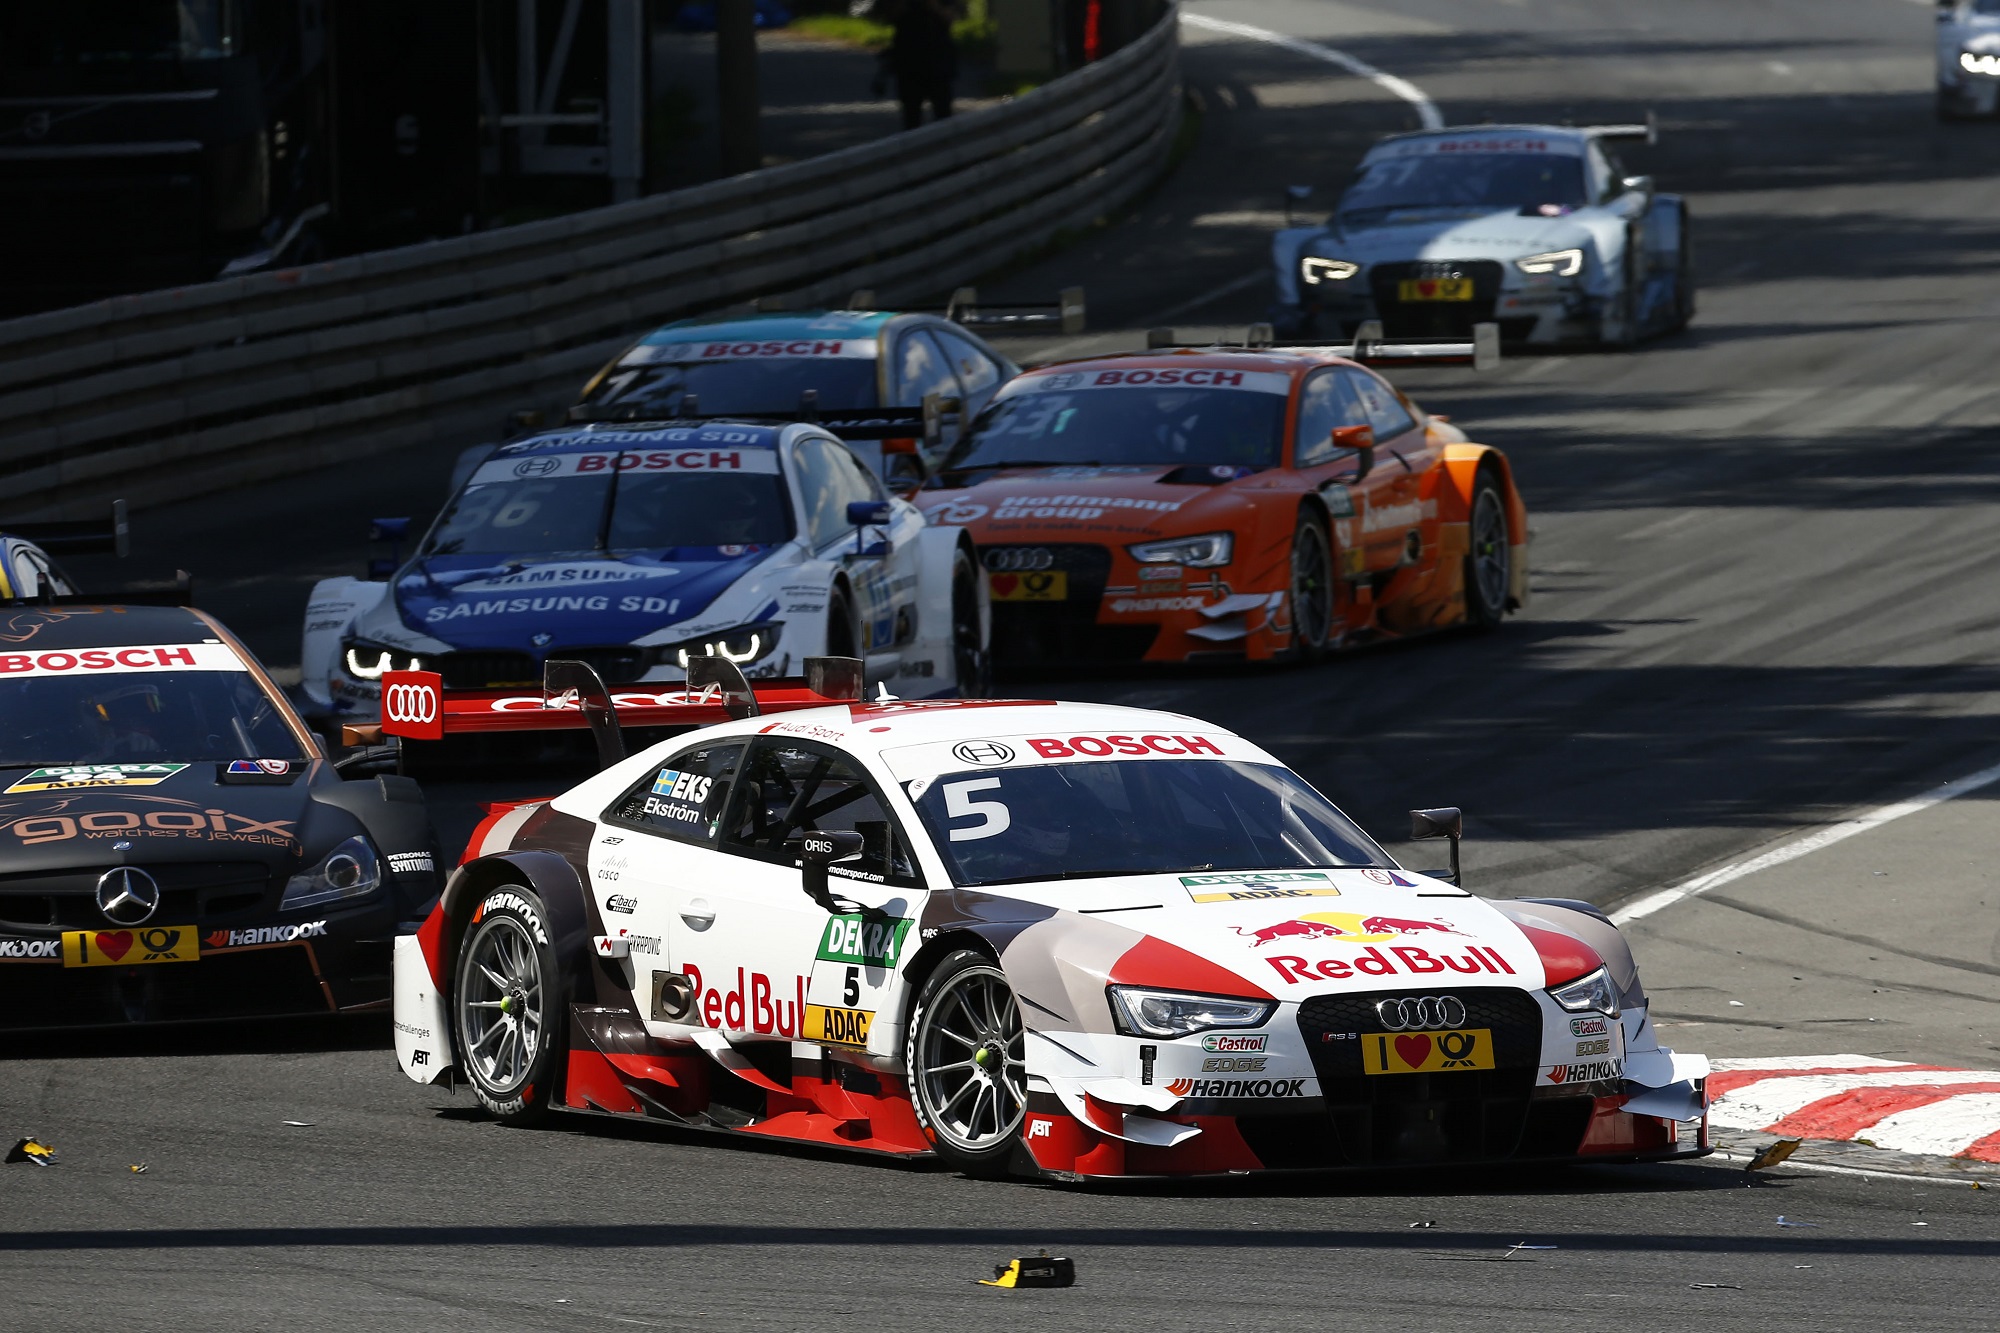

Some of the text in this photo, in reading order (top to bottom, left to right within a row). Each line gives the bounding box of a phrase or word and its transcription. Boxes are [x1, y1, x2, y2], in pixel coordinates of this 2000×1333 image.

[1438, 140, 1547, 151] BOSCH
[702, 341, 842, 357] BOSCH
[1094, 370, 1243, 386] BOSCH
[699, 430, 759, 444] SDI
[576, 452, 741, 472] BOSCH
[1000, 495, 1182, 512] Hoffmann
[992, 506, 1104, 520] Group
[425, 595, 682, 623] SAMSUNG SDI
[0, 648, 197, 673] BOSCH
[779, 722, 846, 742] Audi Sport
[1025, 735, 1227, 759] BOSCH
[40, 764, 172, 777] DEKRA
[45, 779, 128, 788] ADAC
[670, 772, 713, 803] EKS
[643, 797, 699, 824] Ekström
[942, 777, 1011, 842] 5
[14, 809, 297, 844] gooix
[84, 829, 304, 857] watches & jewellery
[804, 839, 833, 853] ORIS
[387, 852, 432, 861] PETRONAS
[1189, 874, 1314, 884] DEKRA
[1249, 883, 1280, 891] 5
[1228, 889, 1314, 900] ADAC
[606, 895, 638, 914] Eibach
[828, 918, 895, 960] DEKRA
[0, 940, 61, 957] KOOK
[1265, 946, 1516, 984] Red Bull
[843, 966, 860, 1007] 5
[683, 963, 811, 1039] Red Bul
[823, 1008, 868, 1044] ADAC
[1580, 1020, 1606, 1034] Castrol
[1218, 1036, 1264, 1051] Castrol
[1576, 1039, 1610, 1056] EDGE
[411, 1050, 430, 1067] ABT
[1201, 1057, 1268, 1073] EDGE
[1028, 1119, 1053, 1140] ABT
